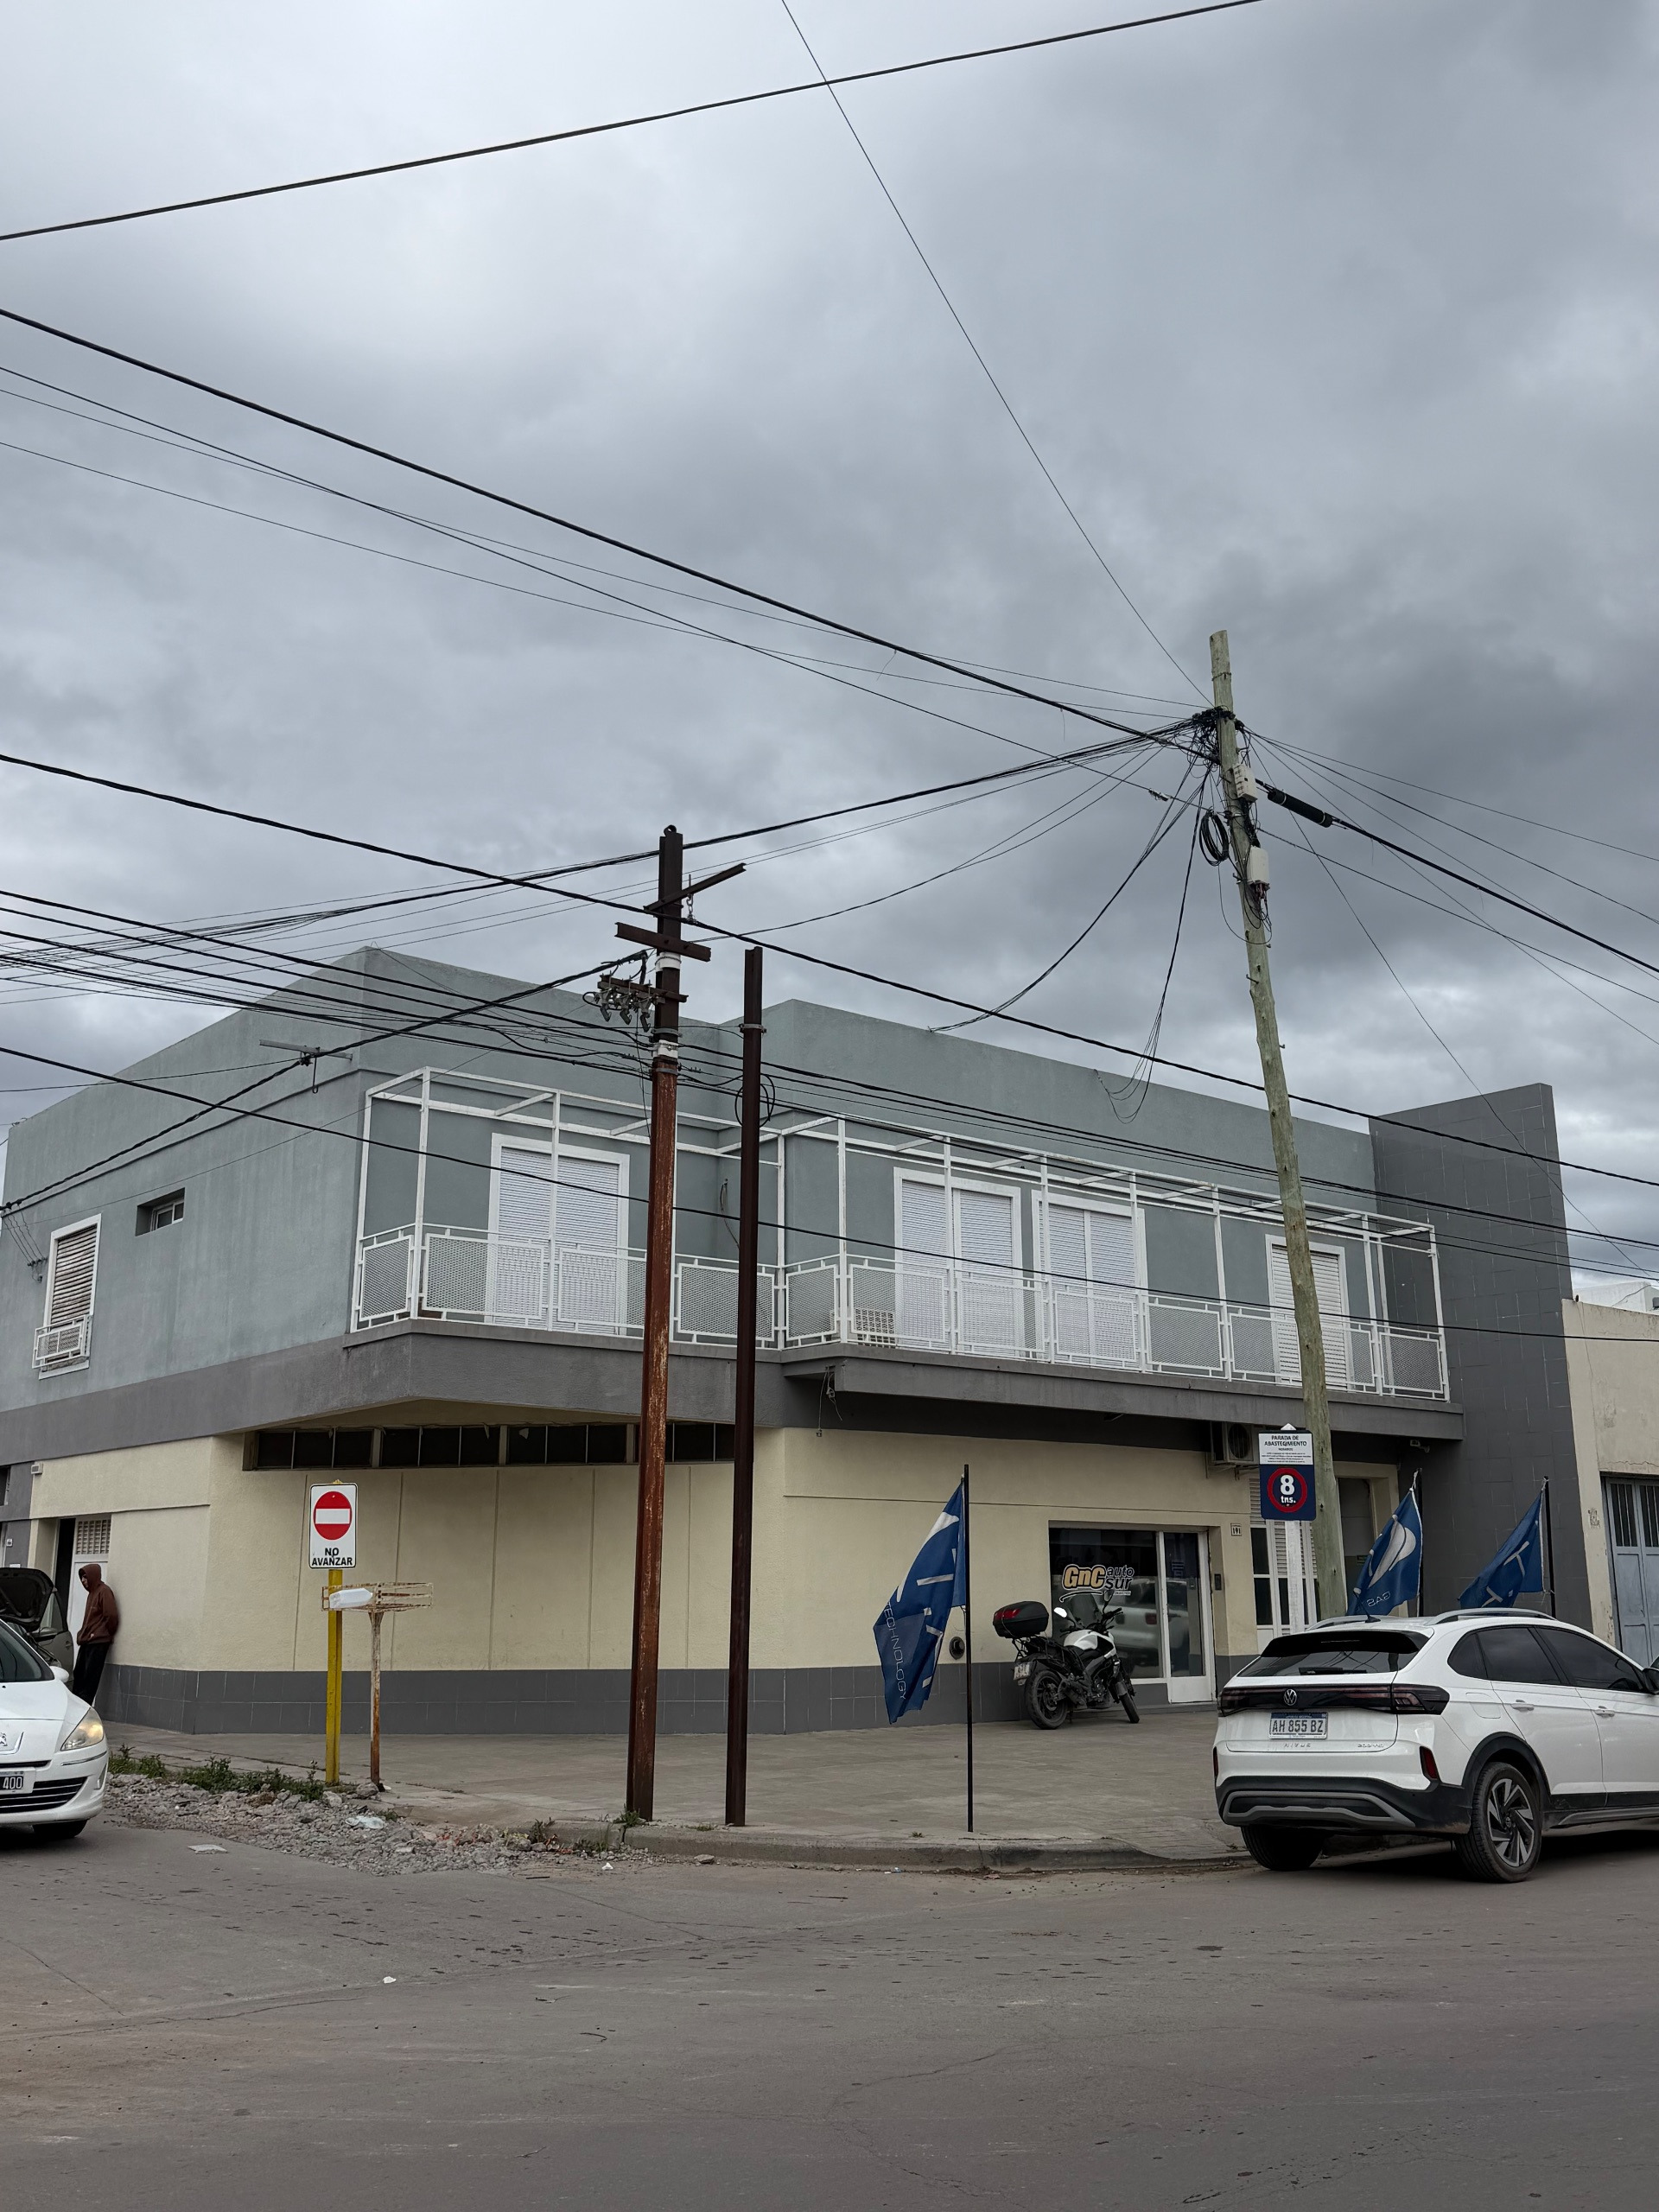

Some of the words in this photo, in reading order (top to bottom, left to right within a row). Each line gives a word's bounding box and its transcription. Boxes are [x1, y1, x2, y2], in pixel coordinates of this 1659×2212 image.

[1280, 1474, 1295, 1496] 8
[324, 1548, 340, 1556] NO
[311, 1557, 353, 1566] AVANZAR
[1063, 1565, 1106, 1590] GnC
[1106, 1565, 1135, 1578] auto
[1105, 1577, 1133, 1590] sur
[1272, 1719, 1285, 1732] AH
[1287, 1719, 1307, 1732] 855
[1310, 1719, 1324, 1733] BZ
[3, 1777, 22, 1789] 400
